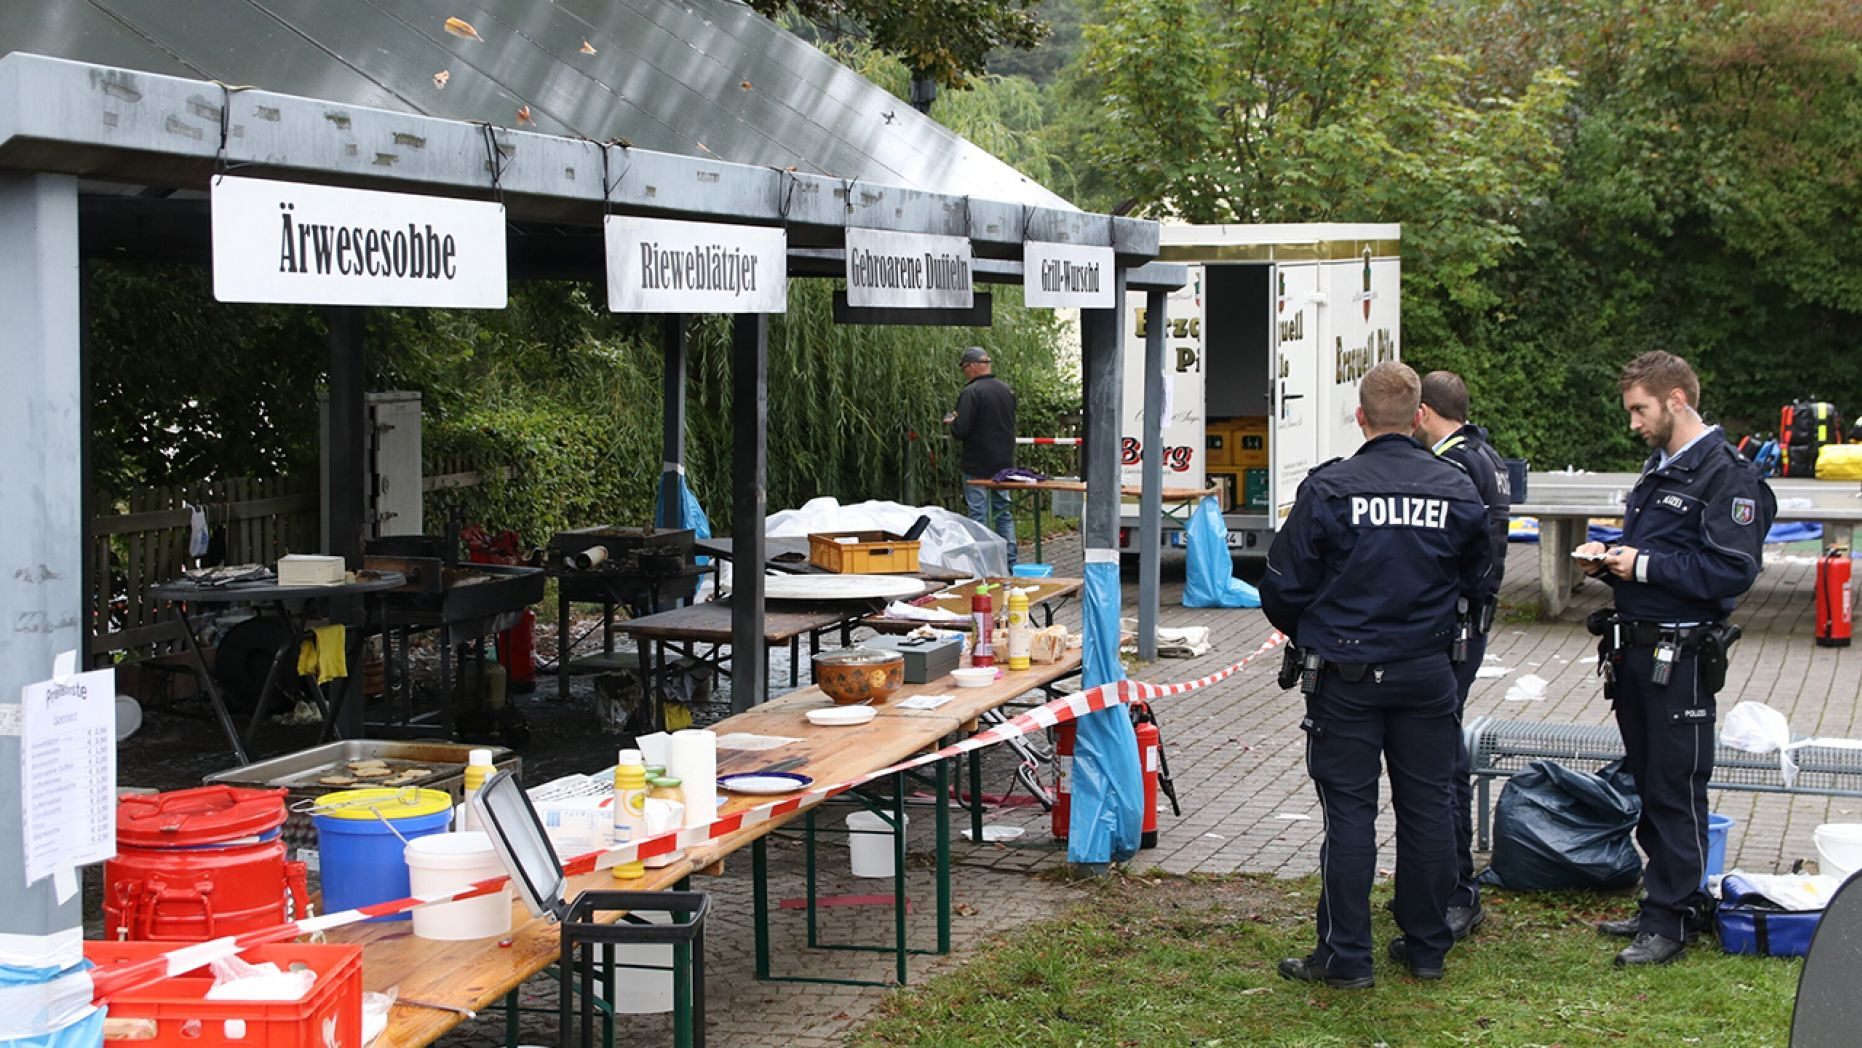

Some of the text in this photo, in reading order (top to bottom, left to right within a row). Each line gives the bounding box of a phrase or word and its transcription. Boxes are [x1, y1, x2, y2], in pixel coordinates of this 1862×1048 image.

[279, 202, 457, 279] Ärwesesobbe
[640, 242, 757, 297] Rieweblätzjer
[852, 247, 923, 289] Gebroarene
[1041, 259, 1099, 292] Grill-Wurschd
[1121, 437, 1193, 472] Brg
[1351, 497, 1449, 529] POLIZEI
